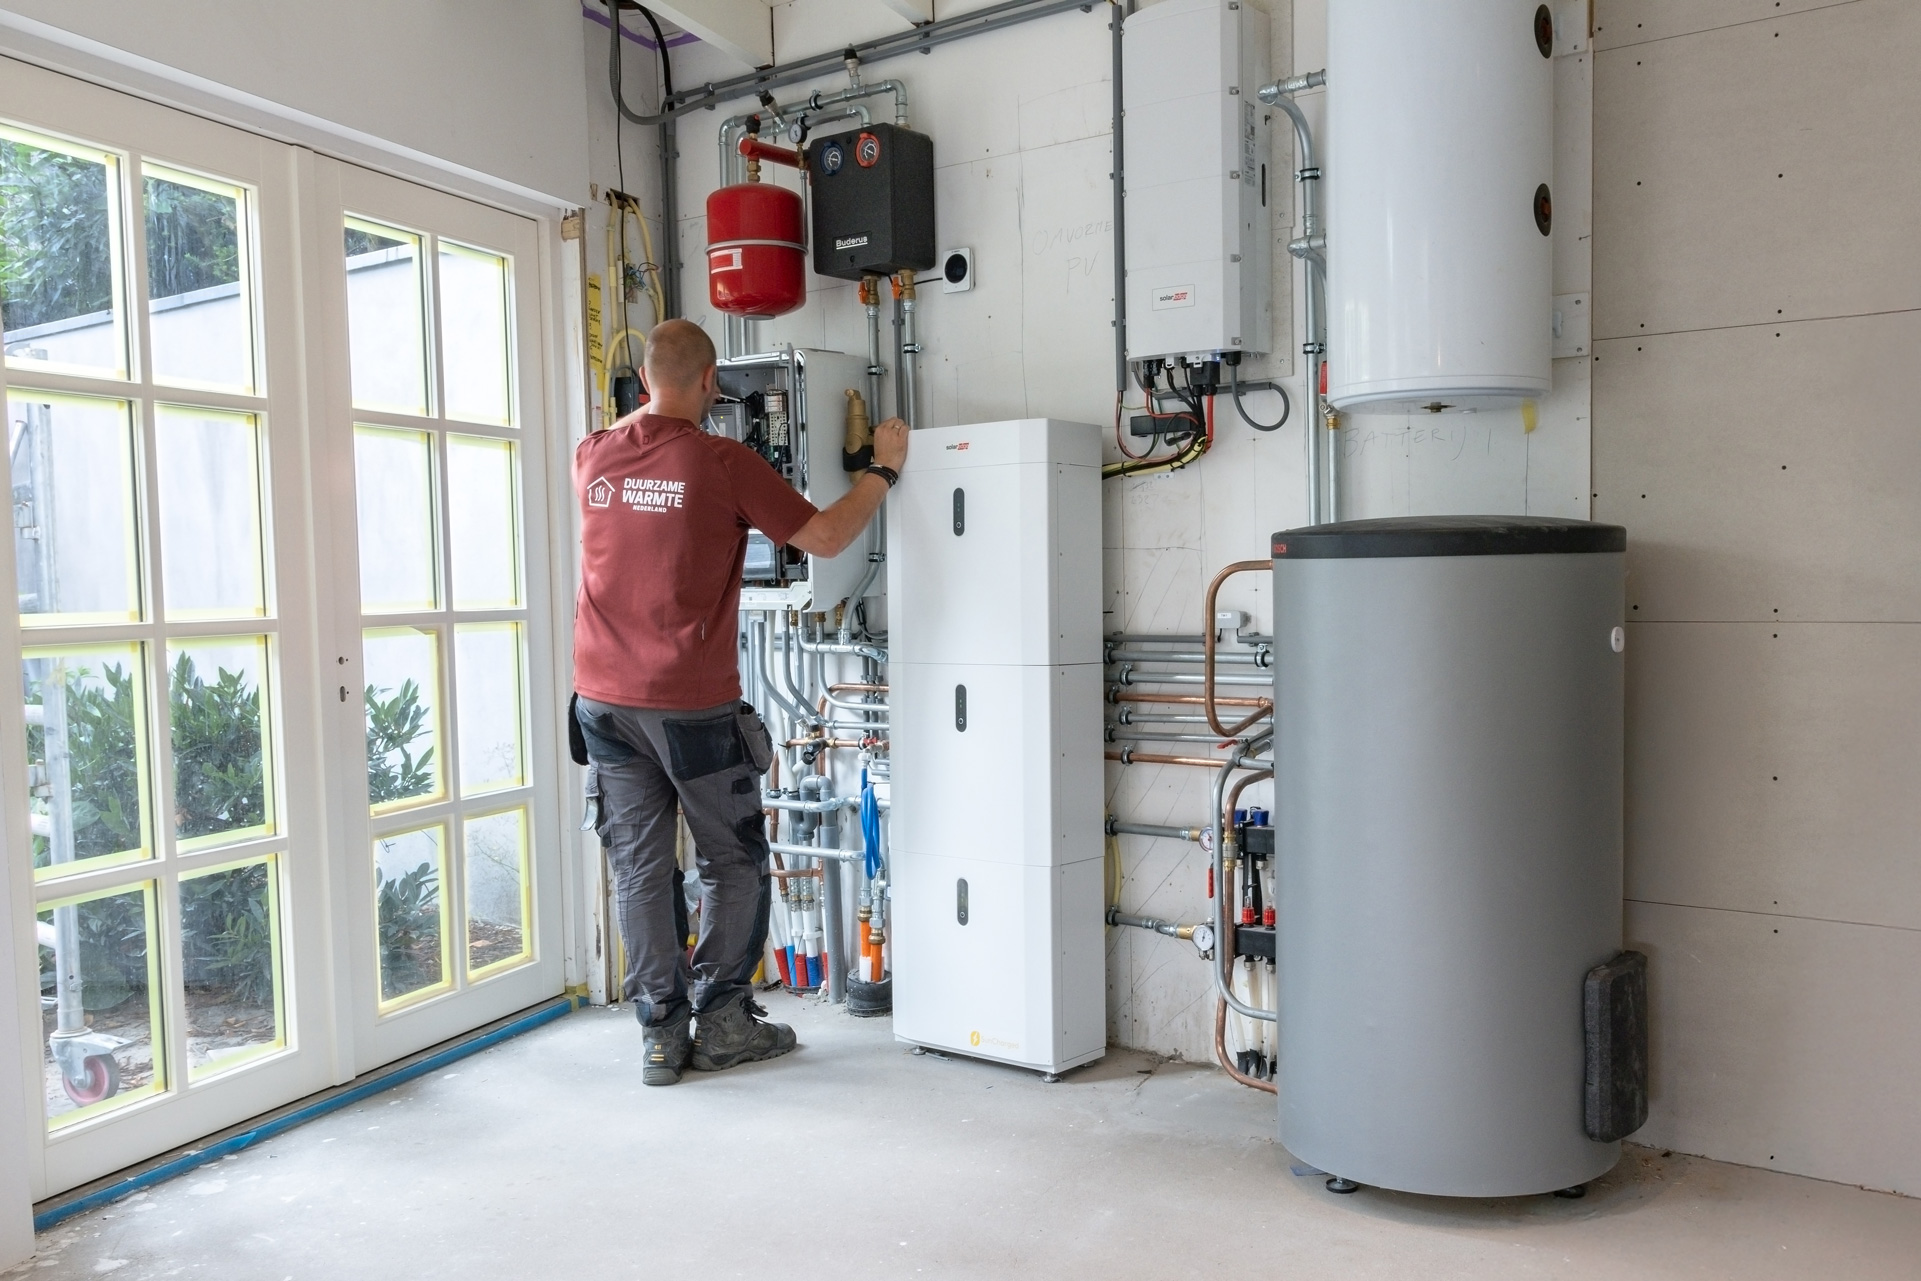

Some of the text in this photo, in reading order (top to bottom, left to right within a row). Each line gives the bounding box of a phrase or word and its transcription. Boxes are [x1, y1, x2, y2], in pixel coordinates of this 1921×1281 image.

[835, 236, 868, 247] Buderus
[1066, 250, 1100, 295] PV
[623, 478, 686, 493] DUURZAME
[622, 489, 684, 508] WARMTE
[632, 504, 667, 513] NEDERLAND
